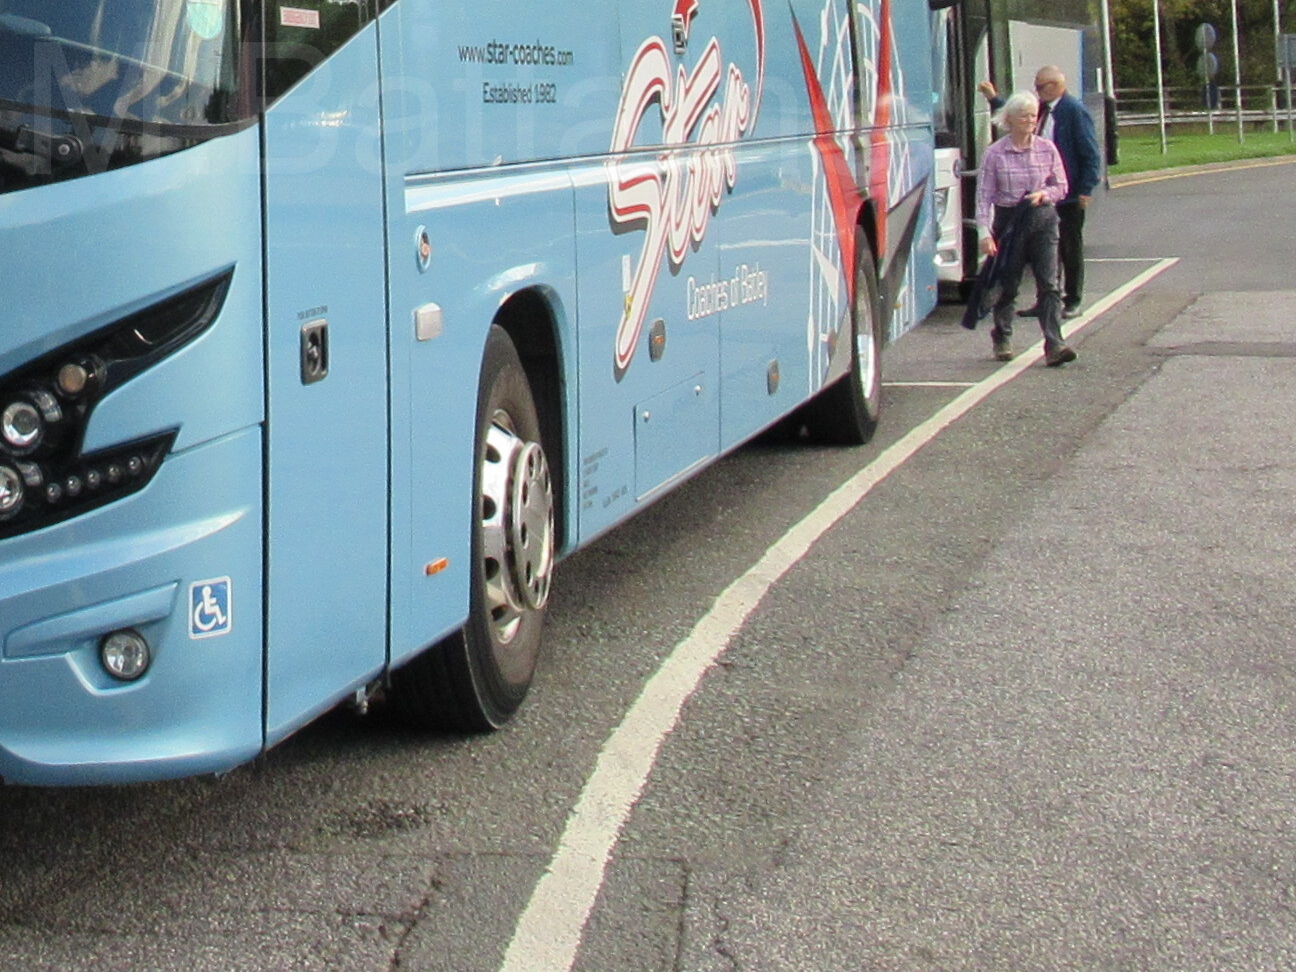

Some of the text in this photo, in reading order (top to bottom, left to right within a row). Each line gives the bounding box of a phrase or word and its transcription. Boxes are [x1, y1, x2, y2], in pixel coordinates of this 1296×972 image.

[457, 38, 574, 66] www.star-coaches.com
[482, 81, 557, 104] Established 1982
[605, 35, 752, 375] Star
[687, 274, 728, 321] Coaches
[730, 265, 740, 307] of
